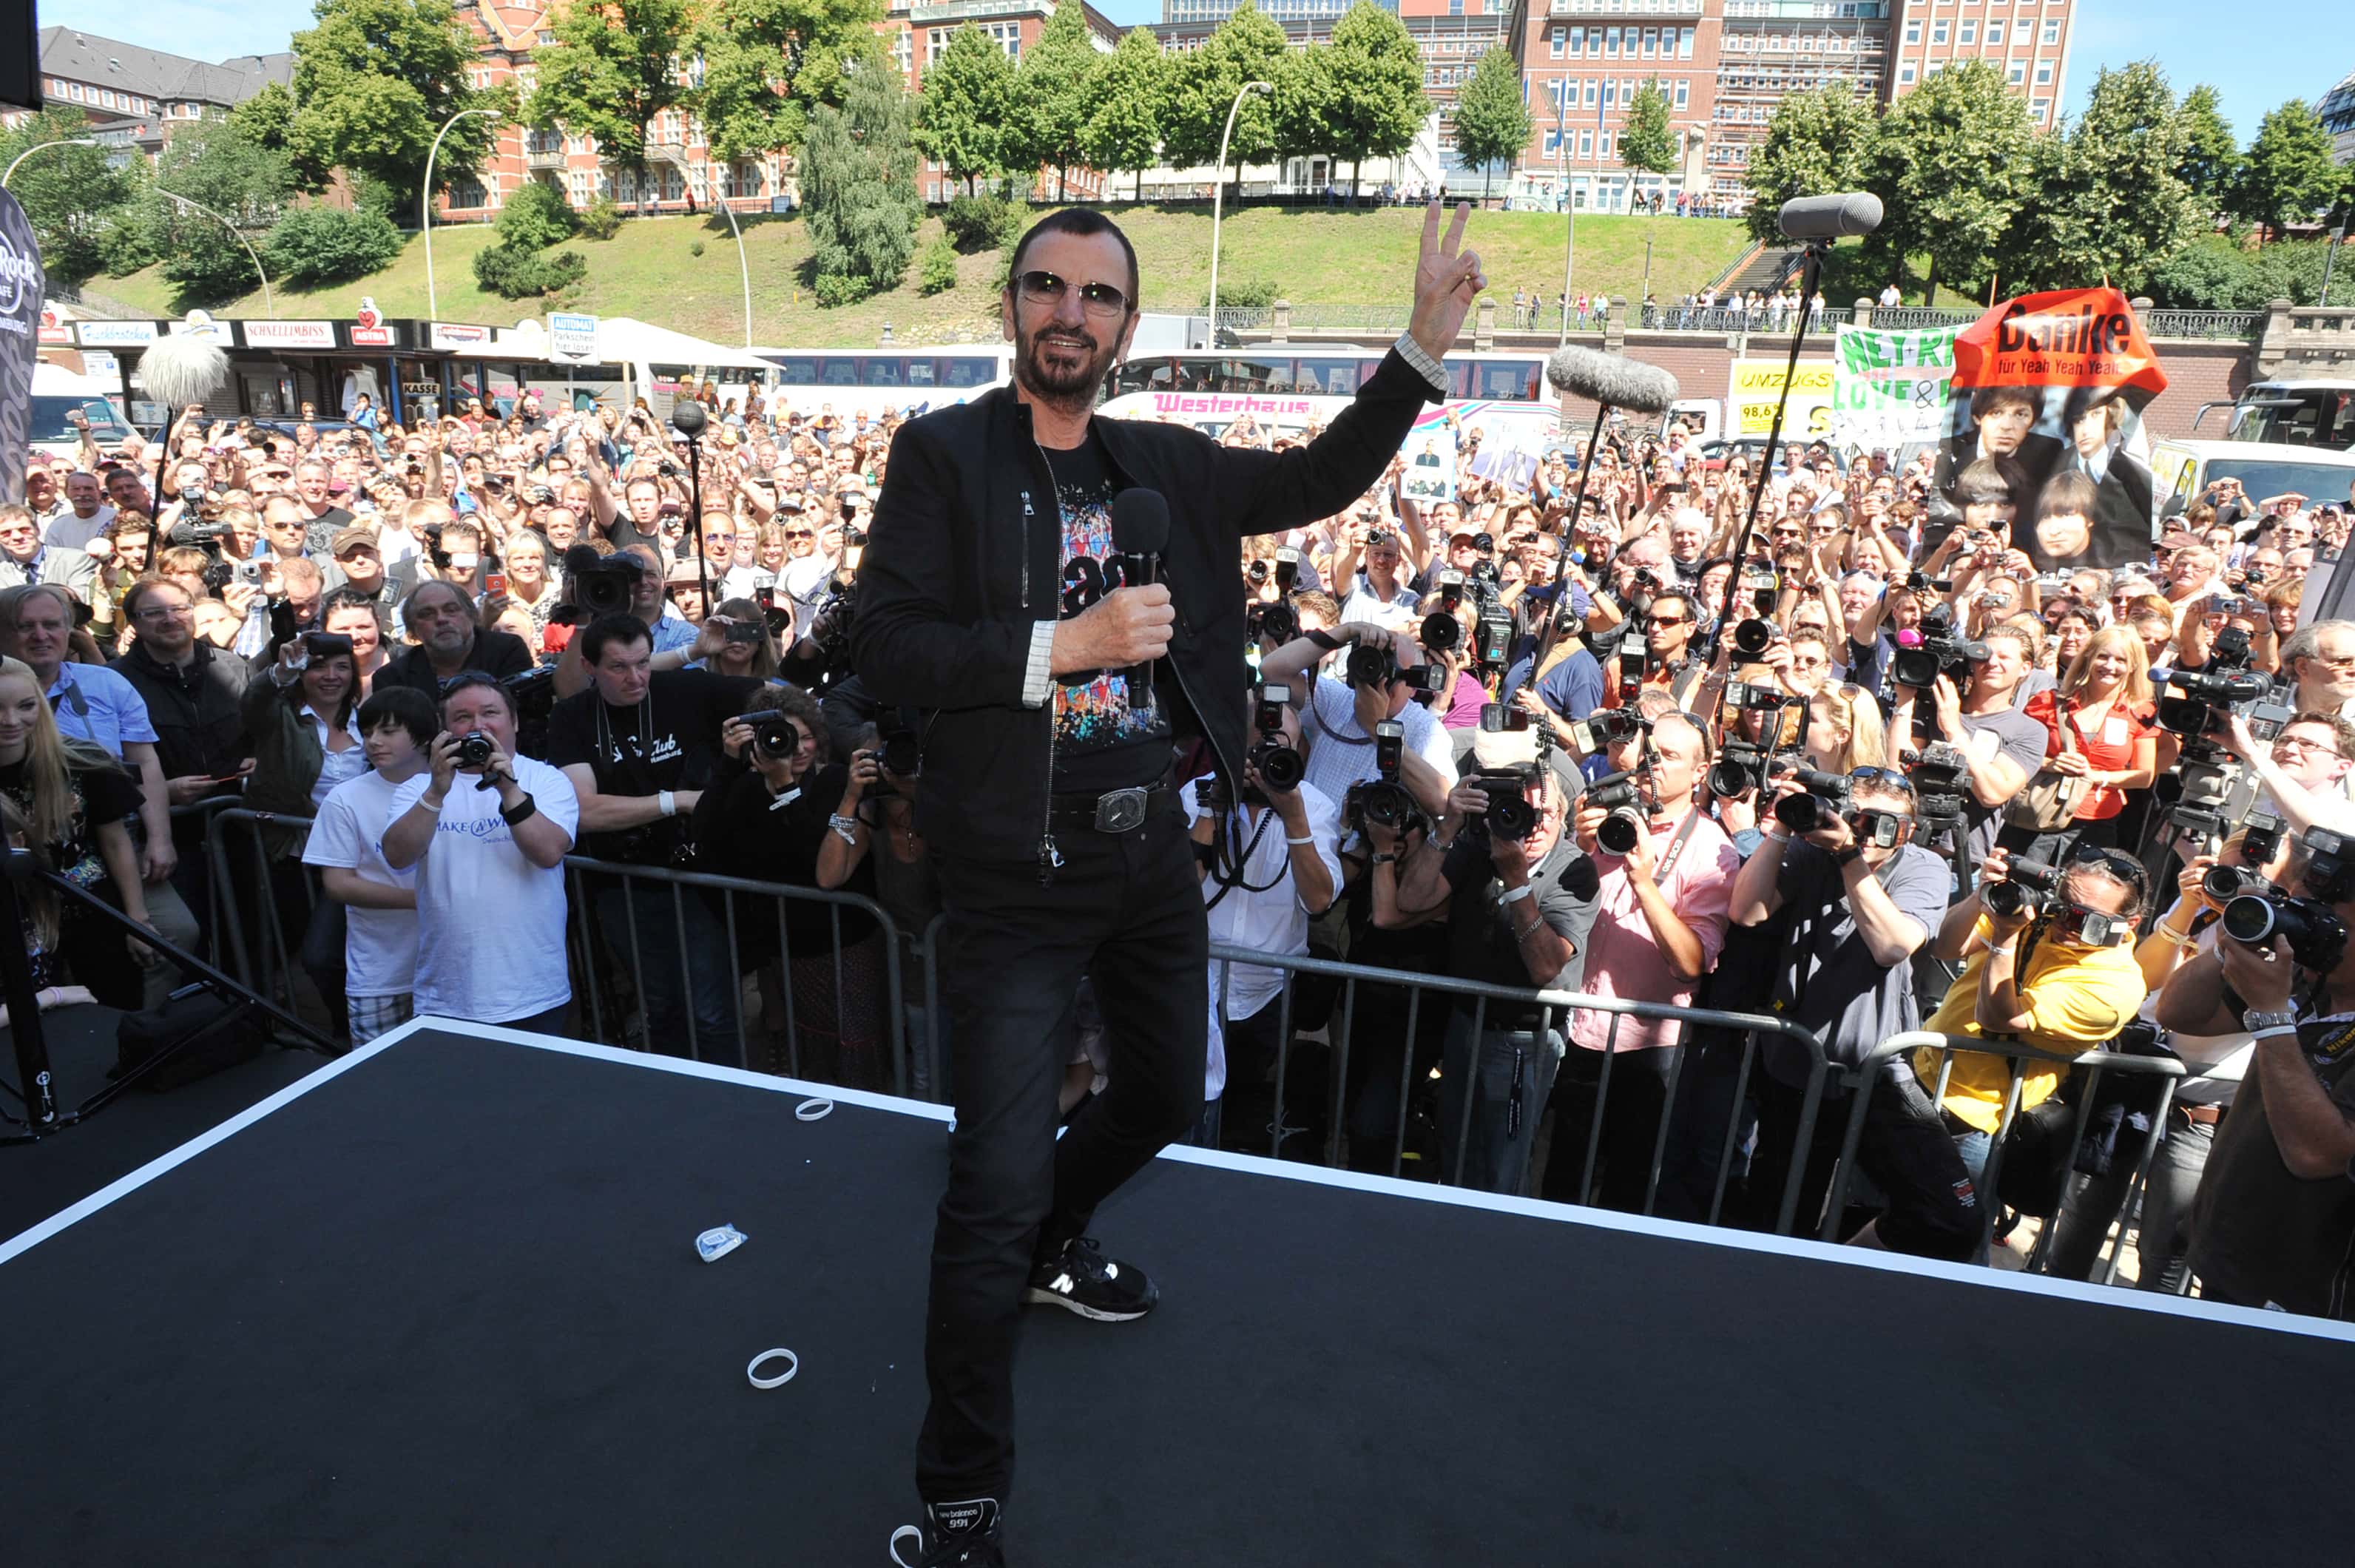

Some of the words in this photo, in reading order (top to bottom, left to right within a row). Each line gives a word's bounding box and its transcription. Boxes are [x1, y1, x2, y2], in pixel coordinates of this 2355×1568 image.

[248, 325, 325, 337] SCHNELLIMBISS
[555, 317, 593, 332] AUTOMAT
[1998, 303, 2131, 354] Danke
[354, 331, 386, 342] ASTRA
[1840, 331, 1906, 375] HEY
[1998, 359, 2016, 374] für
[2021, 359, 2050, 374] Yeah
[2055, 359, 2083, 375] Yeah
[1741, 372, 1834, 388] UMZUGS
[404, 384, 438, 393] KASSE
[1834, 380, 1912, 410] LOVE
[1915, 379, 1934, 409] &
[1154, 393, 1309, 413] Westerhaus
